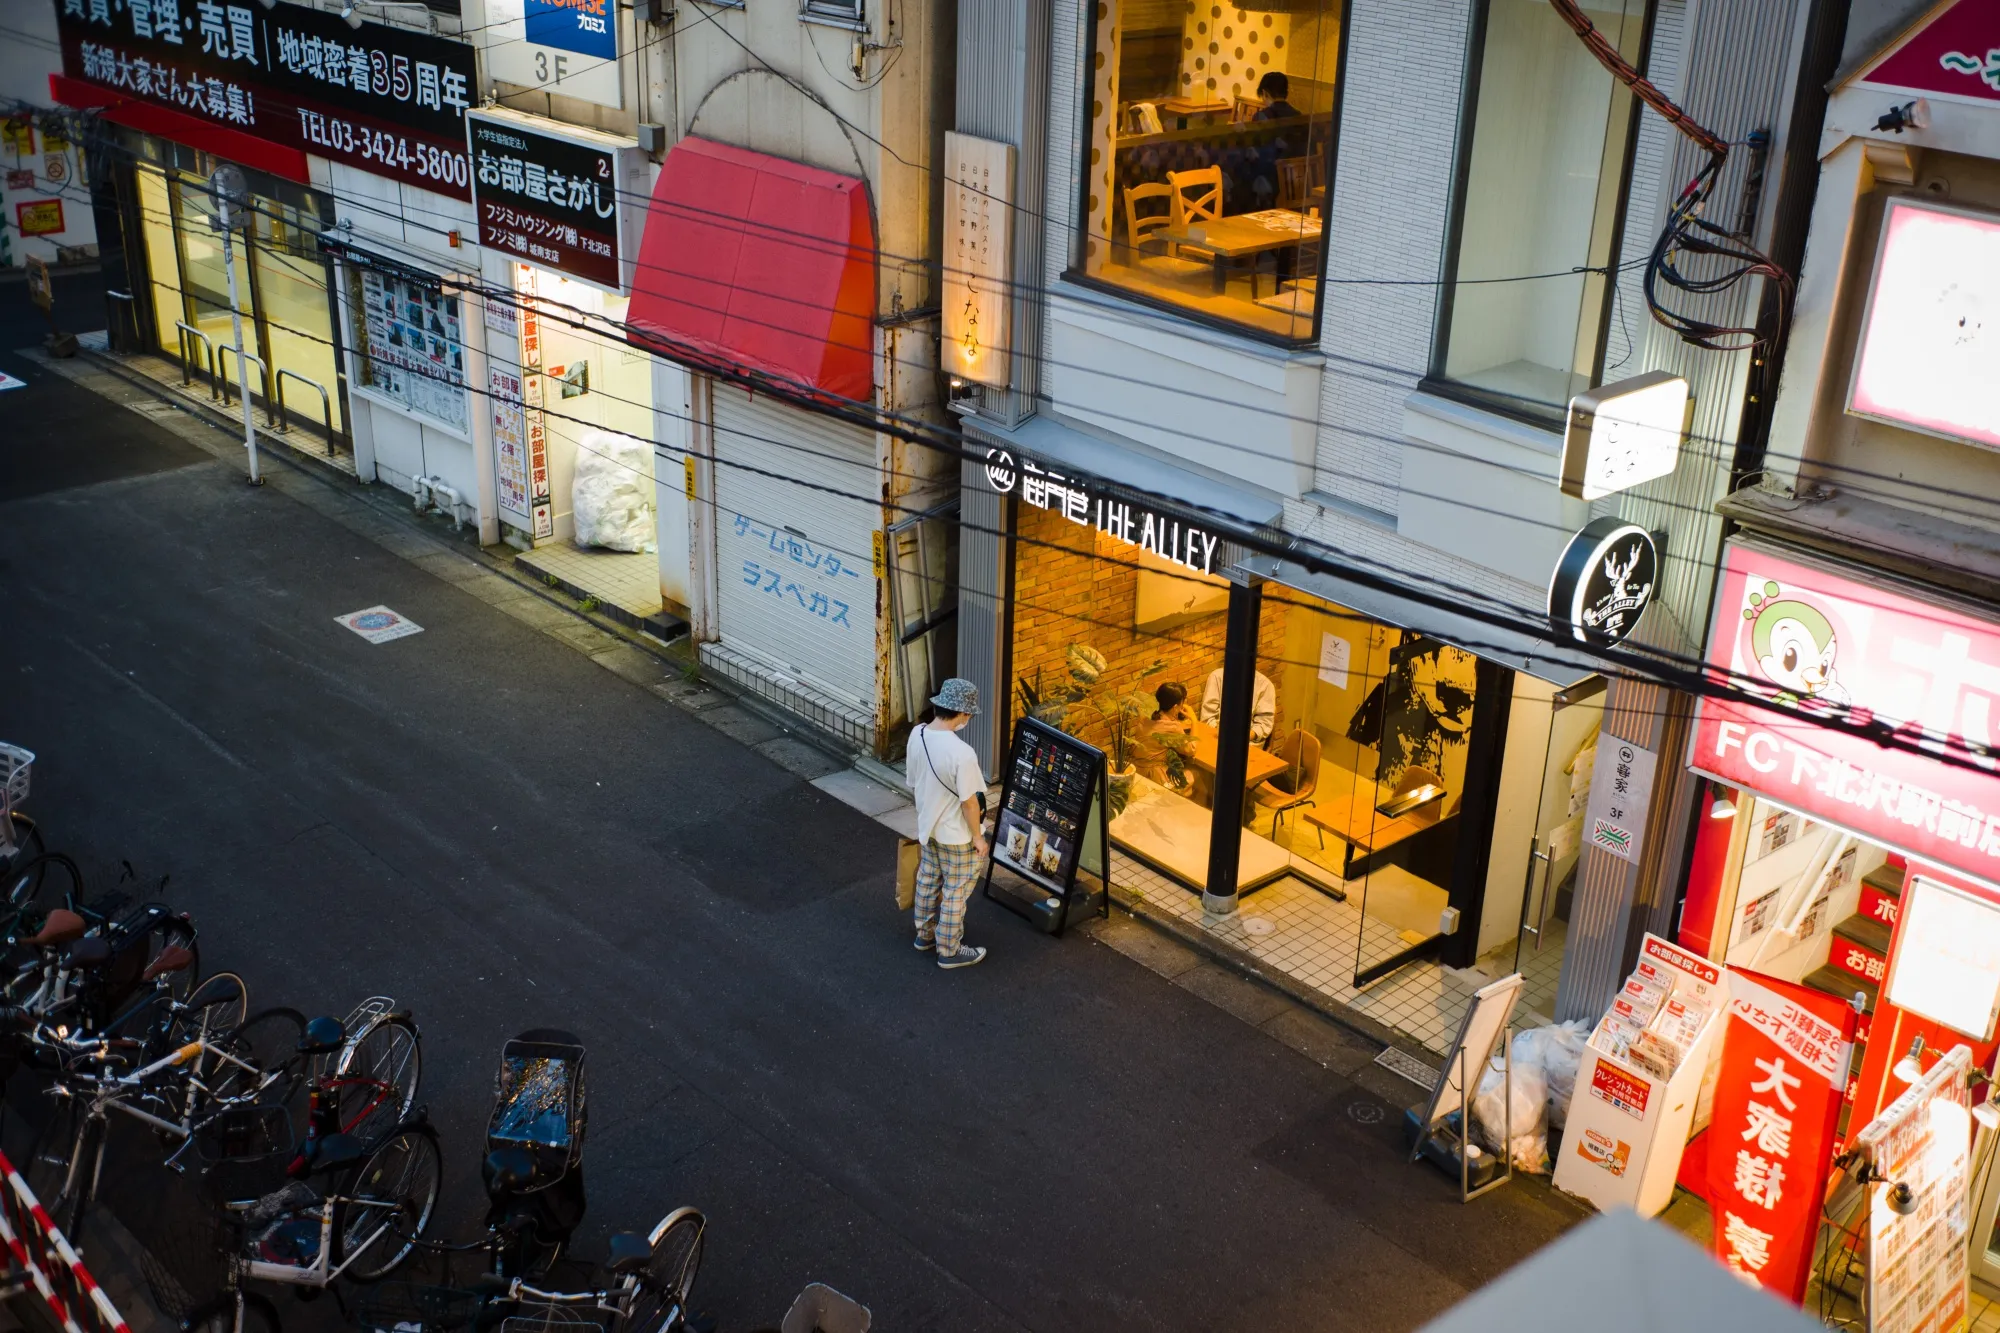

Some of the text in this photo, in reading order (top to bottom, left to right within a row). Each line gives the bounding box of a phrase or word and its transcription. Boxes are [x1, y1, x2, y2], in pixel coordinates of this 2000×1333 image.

[577, 14, 606, 34] プロミス
[277, 27, 470, 117] 地域密着35周年
[297, 107, 468, 188] TEL03-3424-5800
[478, 149, 614, 218] お部屋さがし
[580, 236, 611, 257] 下北沢店
[522, 291, 539, 366] お部屋探し
[492, 371, 519, 395] お部屋
[531, 425, 546, 497] お部屋探し
[734, 513, 859, 578] ゲームセンター
[1141, 512, 1217, 575] ALLEY
[743, 560, 851, 628] ラスベガス
[1597, 605, 1612, 620] THE
[1613, 599, 1635, 611] ALLEY
[1022, 729, 1039, 742] MENU
[1610, 807, 1623, 820] 3F
[1650, 942, 1704, 976] お部屋探し
[1596, 1068, 1648, 1100] クレジットカード
